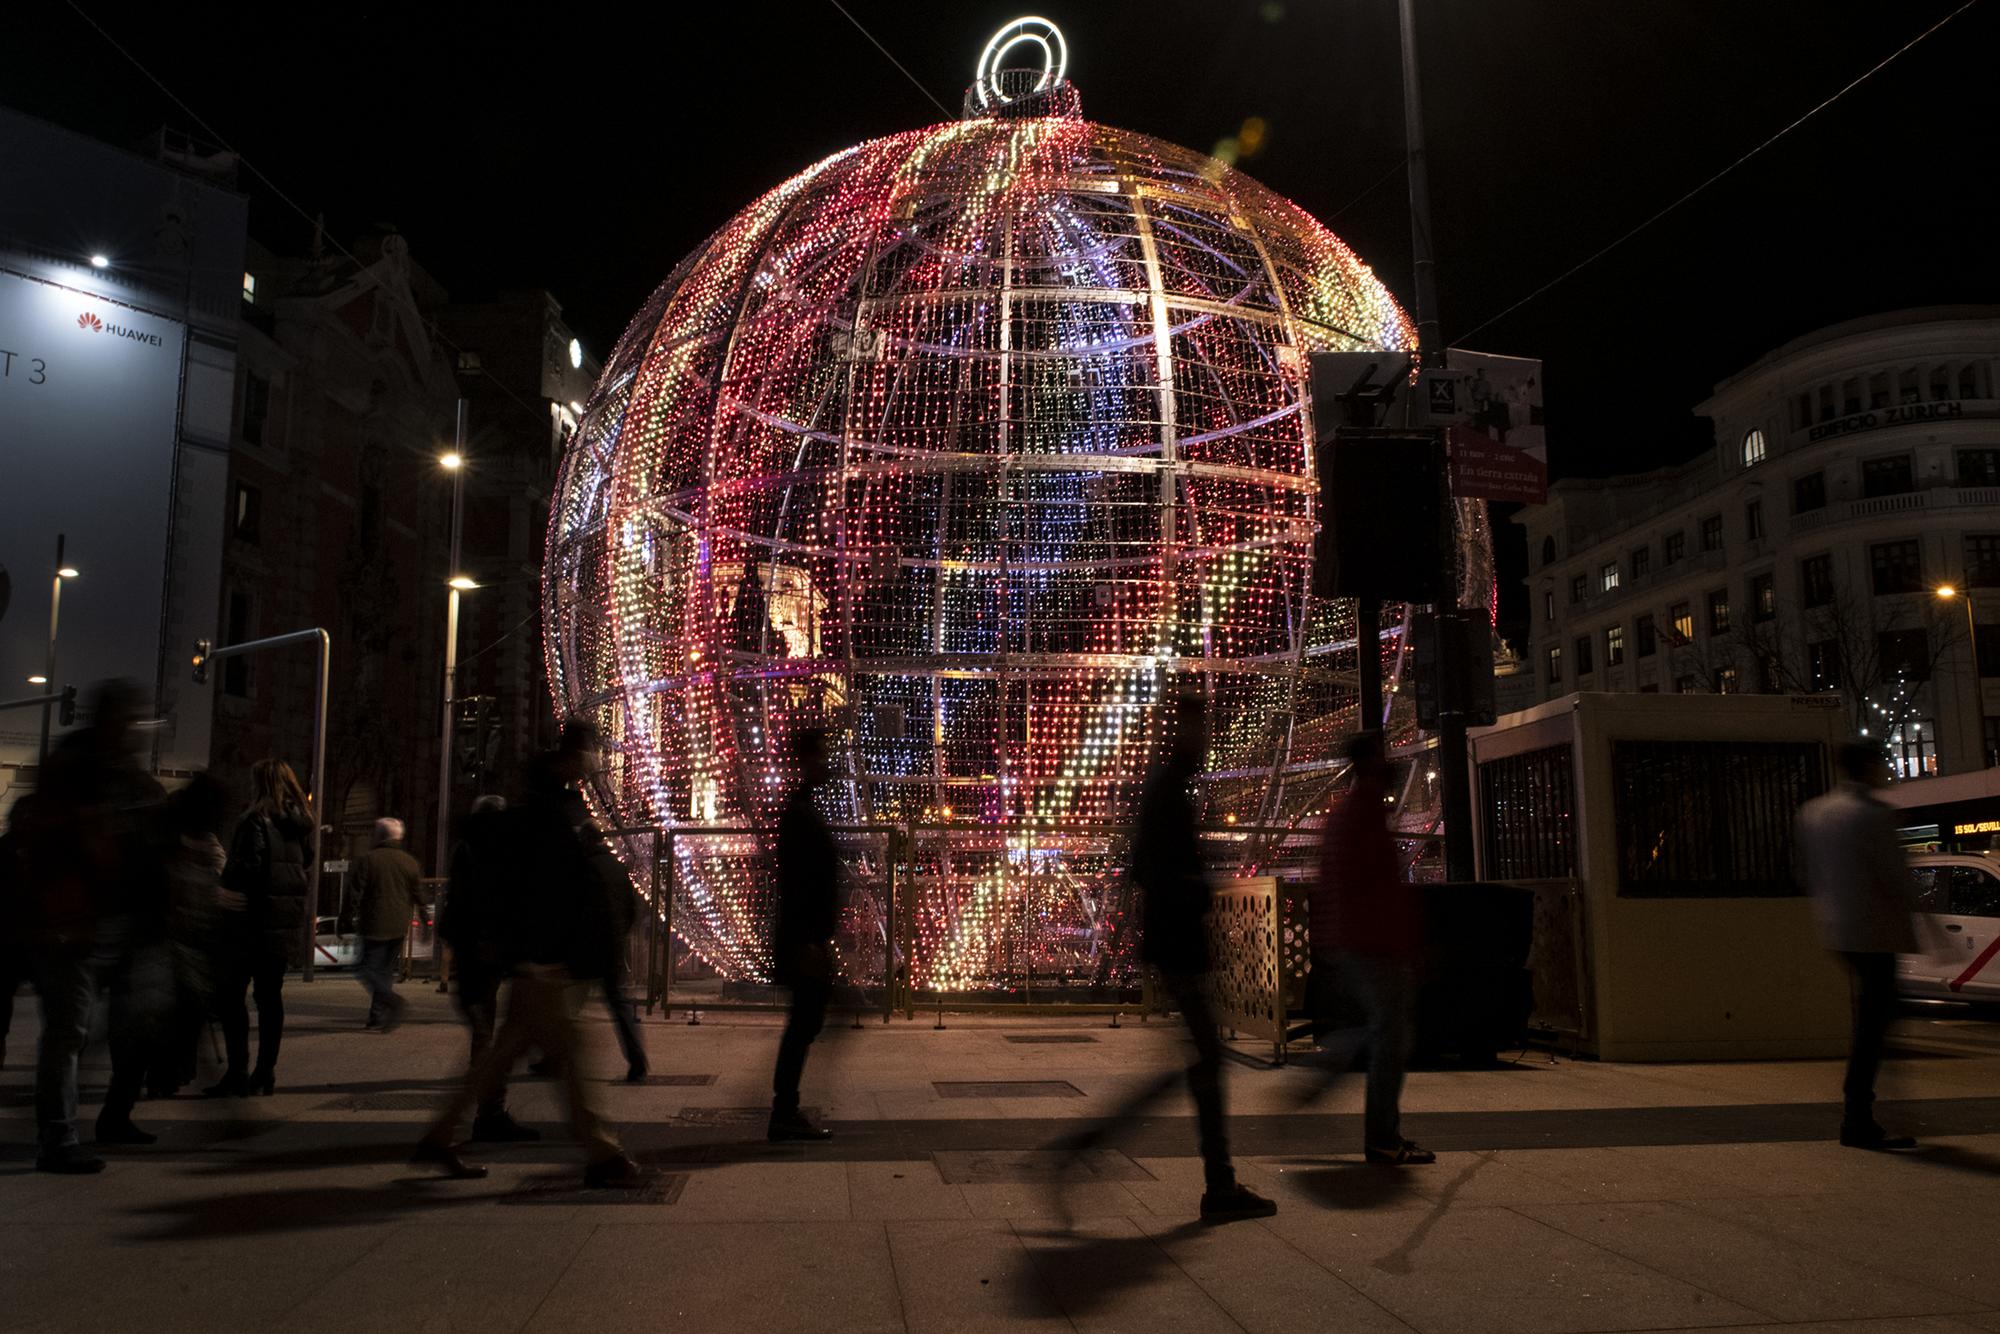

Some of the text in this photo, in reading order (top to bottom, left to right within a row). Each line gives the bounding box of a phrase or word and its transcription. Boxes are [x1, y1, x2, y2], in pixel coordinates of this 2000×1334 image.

[106, 322, 163, 347] HUAWEI
[0, 350, 46, 385] T 3
[1809, 401, 1963, 442] EDIFICIO ZURICH
[1459, 464, 1474, 476] En
[1476, 466, 1502, 478] tierra
[1955, 825, 1964, 835] 15
